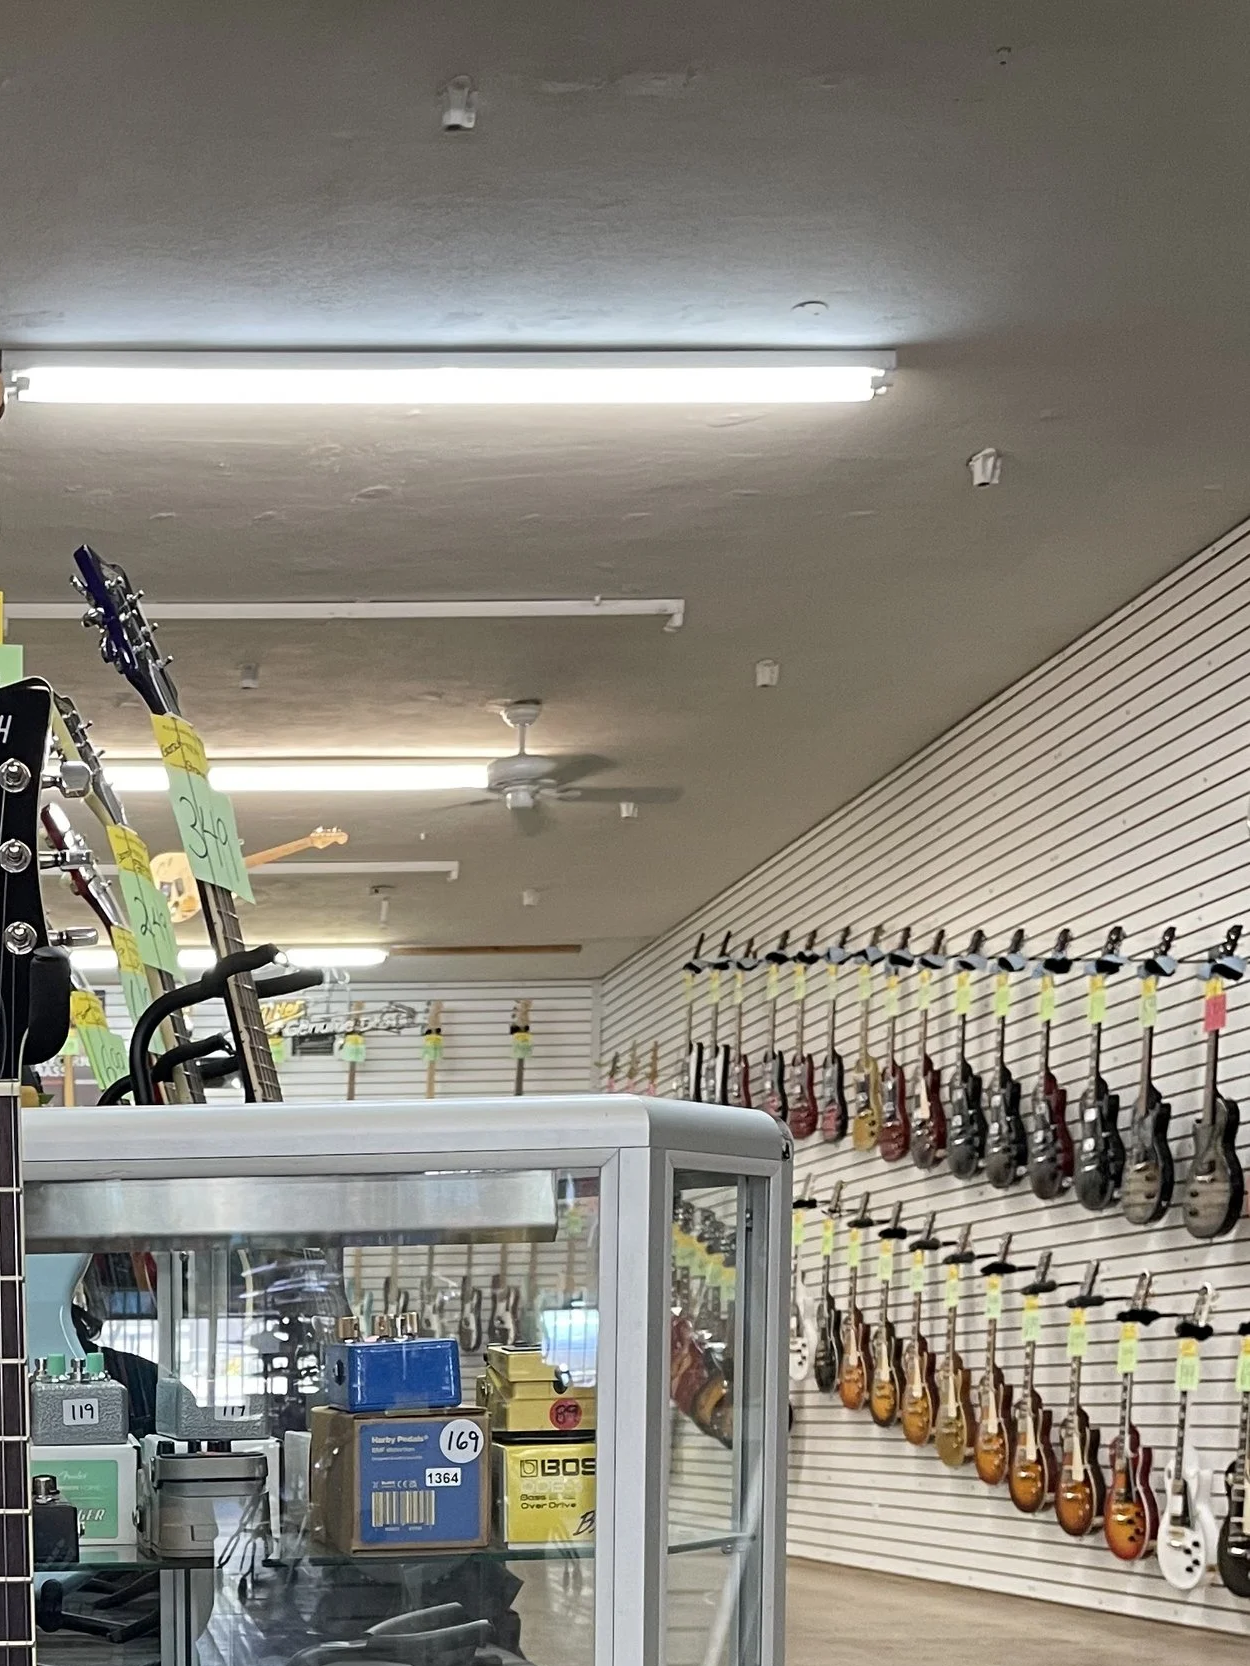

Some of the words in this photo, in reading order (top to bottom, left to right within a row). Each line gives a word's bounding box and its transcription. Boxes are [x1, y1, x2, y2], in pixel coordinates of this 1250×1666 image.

[71, 1403, 94, 1421] 119
[555, 1403, 579, 1426] 89
[447, 1430, 480, 1453] 169
[541, 1457, 596, 1478] BOS
[426, 1472, 459, 1485] 1364
[520, 1502, 548, 1510] Over
[548, 1501, 577, 1510] Drive
